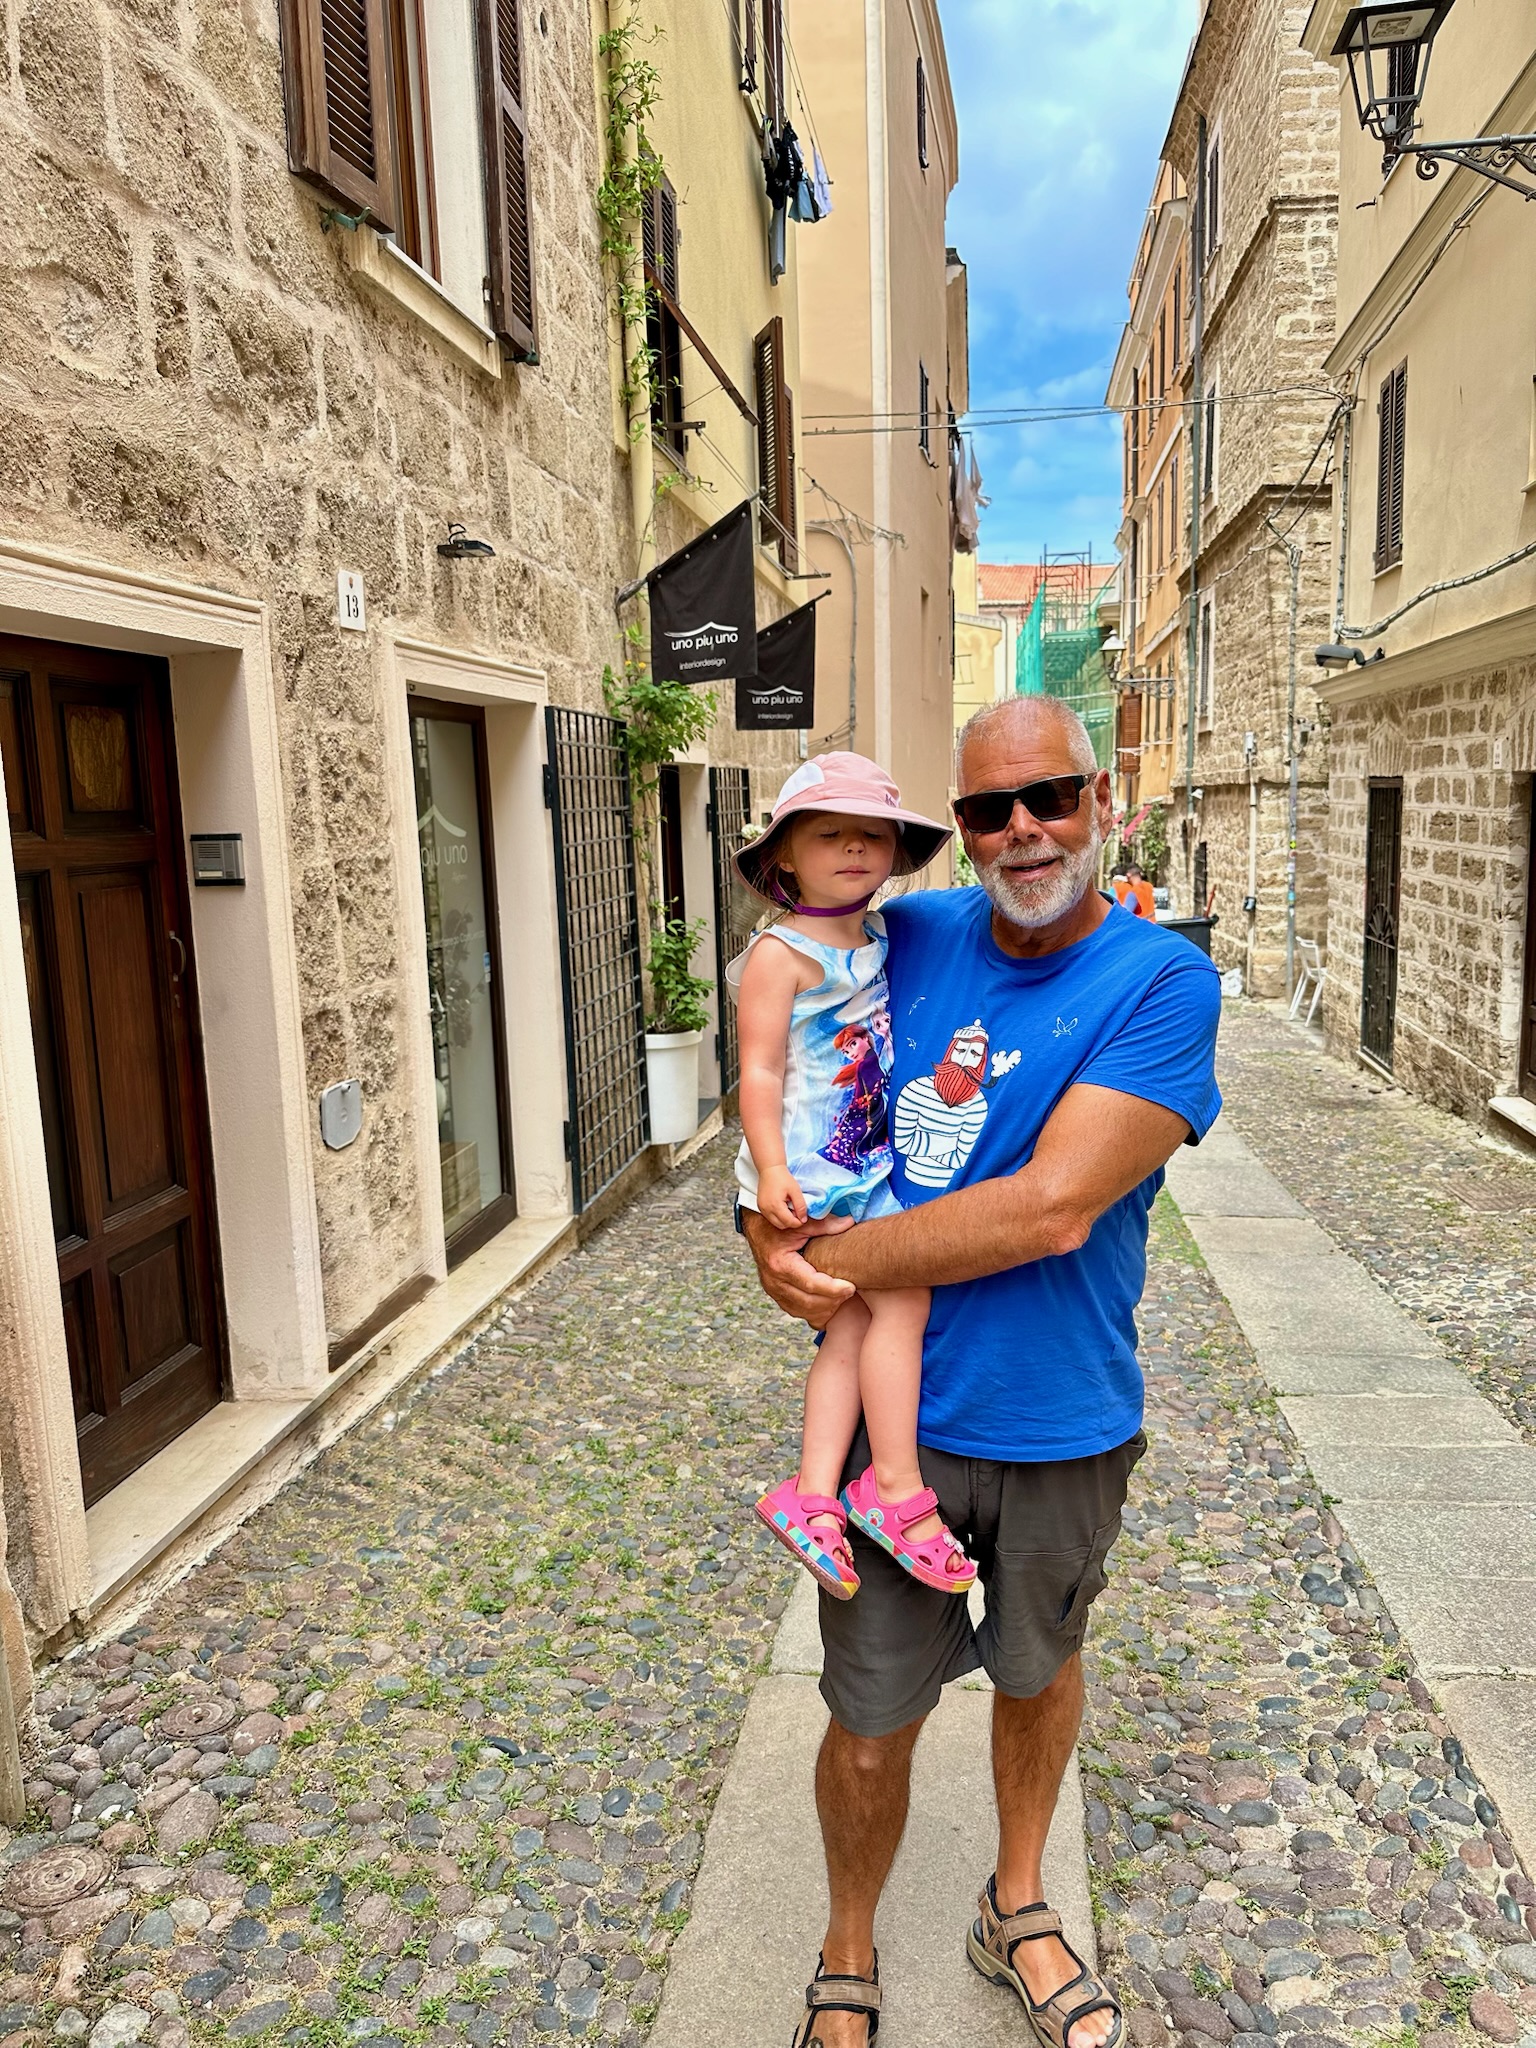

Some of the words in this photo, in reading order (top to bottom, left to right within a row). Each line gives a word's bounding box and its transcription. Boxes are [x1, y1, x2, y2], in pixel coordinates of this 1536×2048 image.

[346, 594, 359, 618] 13
[671, 639, 693, 651] uno
[715, 633, 738, 644] uno
[679, 658, 726, 670] interiordesign
[751, 696, 769, 704] uno
[786, 696, 803, 704] uno
[444, 845, 468, 864] uno
